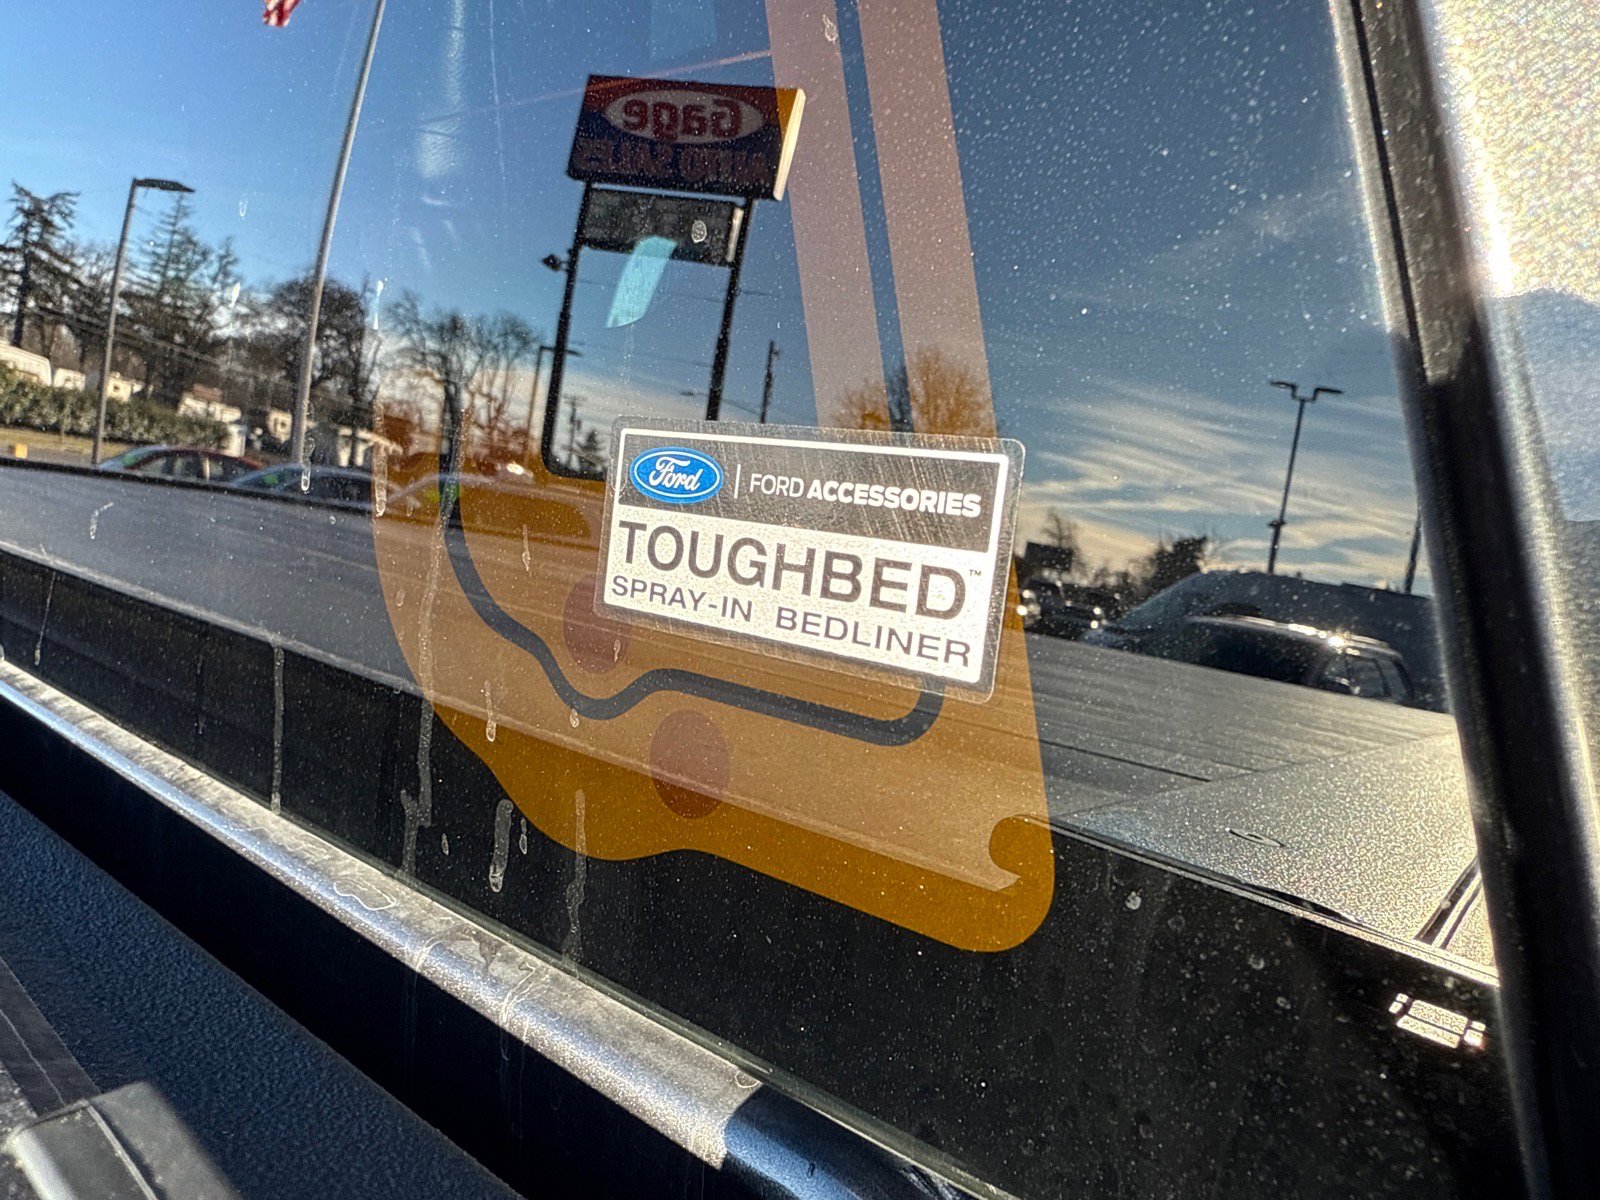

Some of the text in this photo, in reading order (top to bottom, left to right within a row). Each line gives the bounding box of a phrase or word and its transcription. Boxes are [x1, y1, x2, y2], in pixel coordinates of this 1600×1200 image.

[649, 456, 704, 492] Ford
[750, 473, 982, 518] FORD ACCESSORIES
[611, 575, 971, 667] SPRAY-IN BEDLINER
